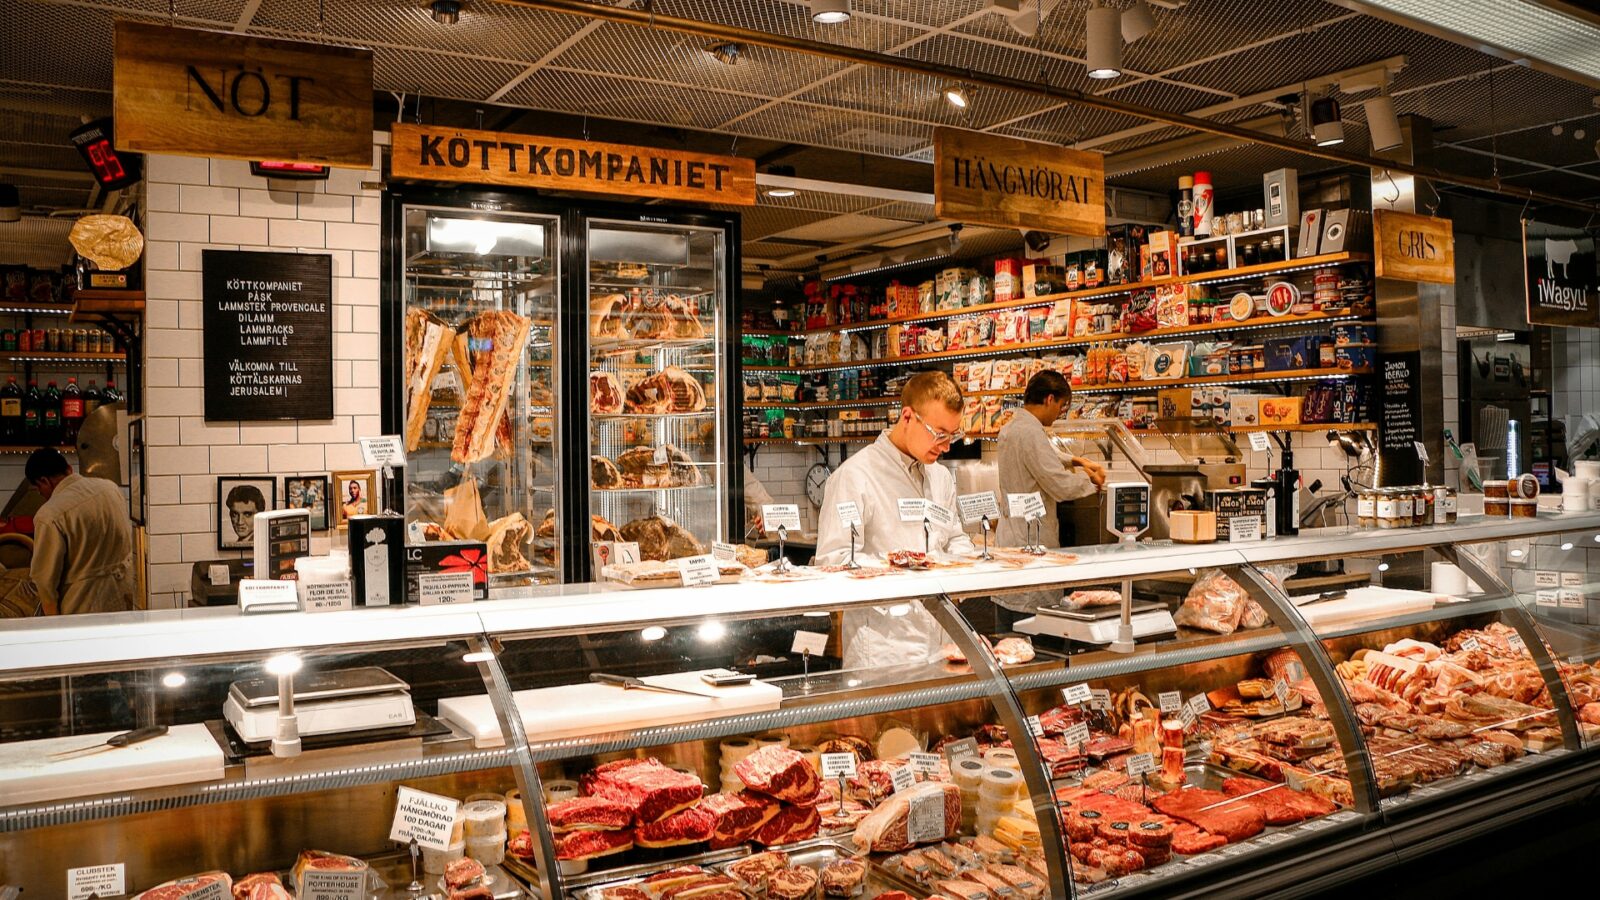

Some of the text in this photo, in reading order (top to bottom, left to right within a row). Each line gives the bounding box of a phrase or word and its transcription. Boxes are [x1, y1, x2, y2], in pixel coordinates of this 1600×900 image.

[185, 63, 314, 121] NÖT
[88, 139, 125, 182] 95
[420, 133, 730, 192] KÖTTKOMPANIET
[953, 154, 1094, 205] HÄNGMÖRAT
[1398, 229, 1436, 261] GRIS
[226, 279, 303, 291] KÖTTKOMPANIET
[248, 290, 272, 301] PÅSK
[1537, 277, 1588, 311] iWagyu
[218, 302, 326, 313] LAMMSTEK PROVENCALE
[238, 313, 275, 323] DILAMM
[240, 325, 294, 335] LAMMRACKS
[240, 332, 288, 346] LAMMFILÉ
[229, 359, 298, 371] VÄLKOMNA TILL
[230, 372, 302, 384] KÖTTÄLSKARNAS
[407, 548, 423, 560] LC
[409, 797, 448, 812] FJÄLLKO
[400, 804, 453, 823] HÄNGMÖRAD
[404, 815, 447, 831] 100 DAGAR
[416, 834, 444, 845] DALARNA
[76, 866, 116, 876] CLUBSTEK
[308, 880, 359, 889] PORTERHOUSE
